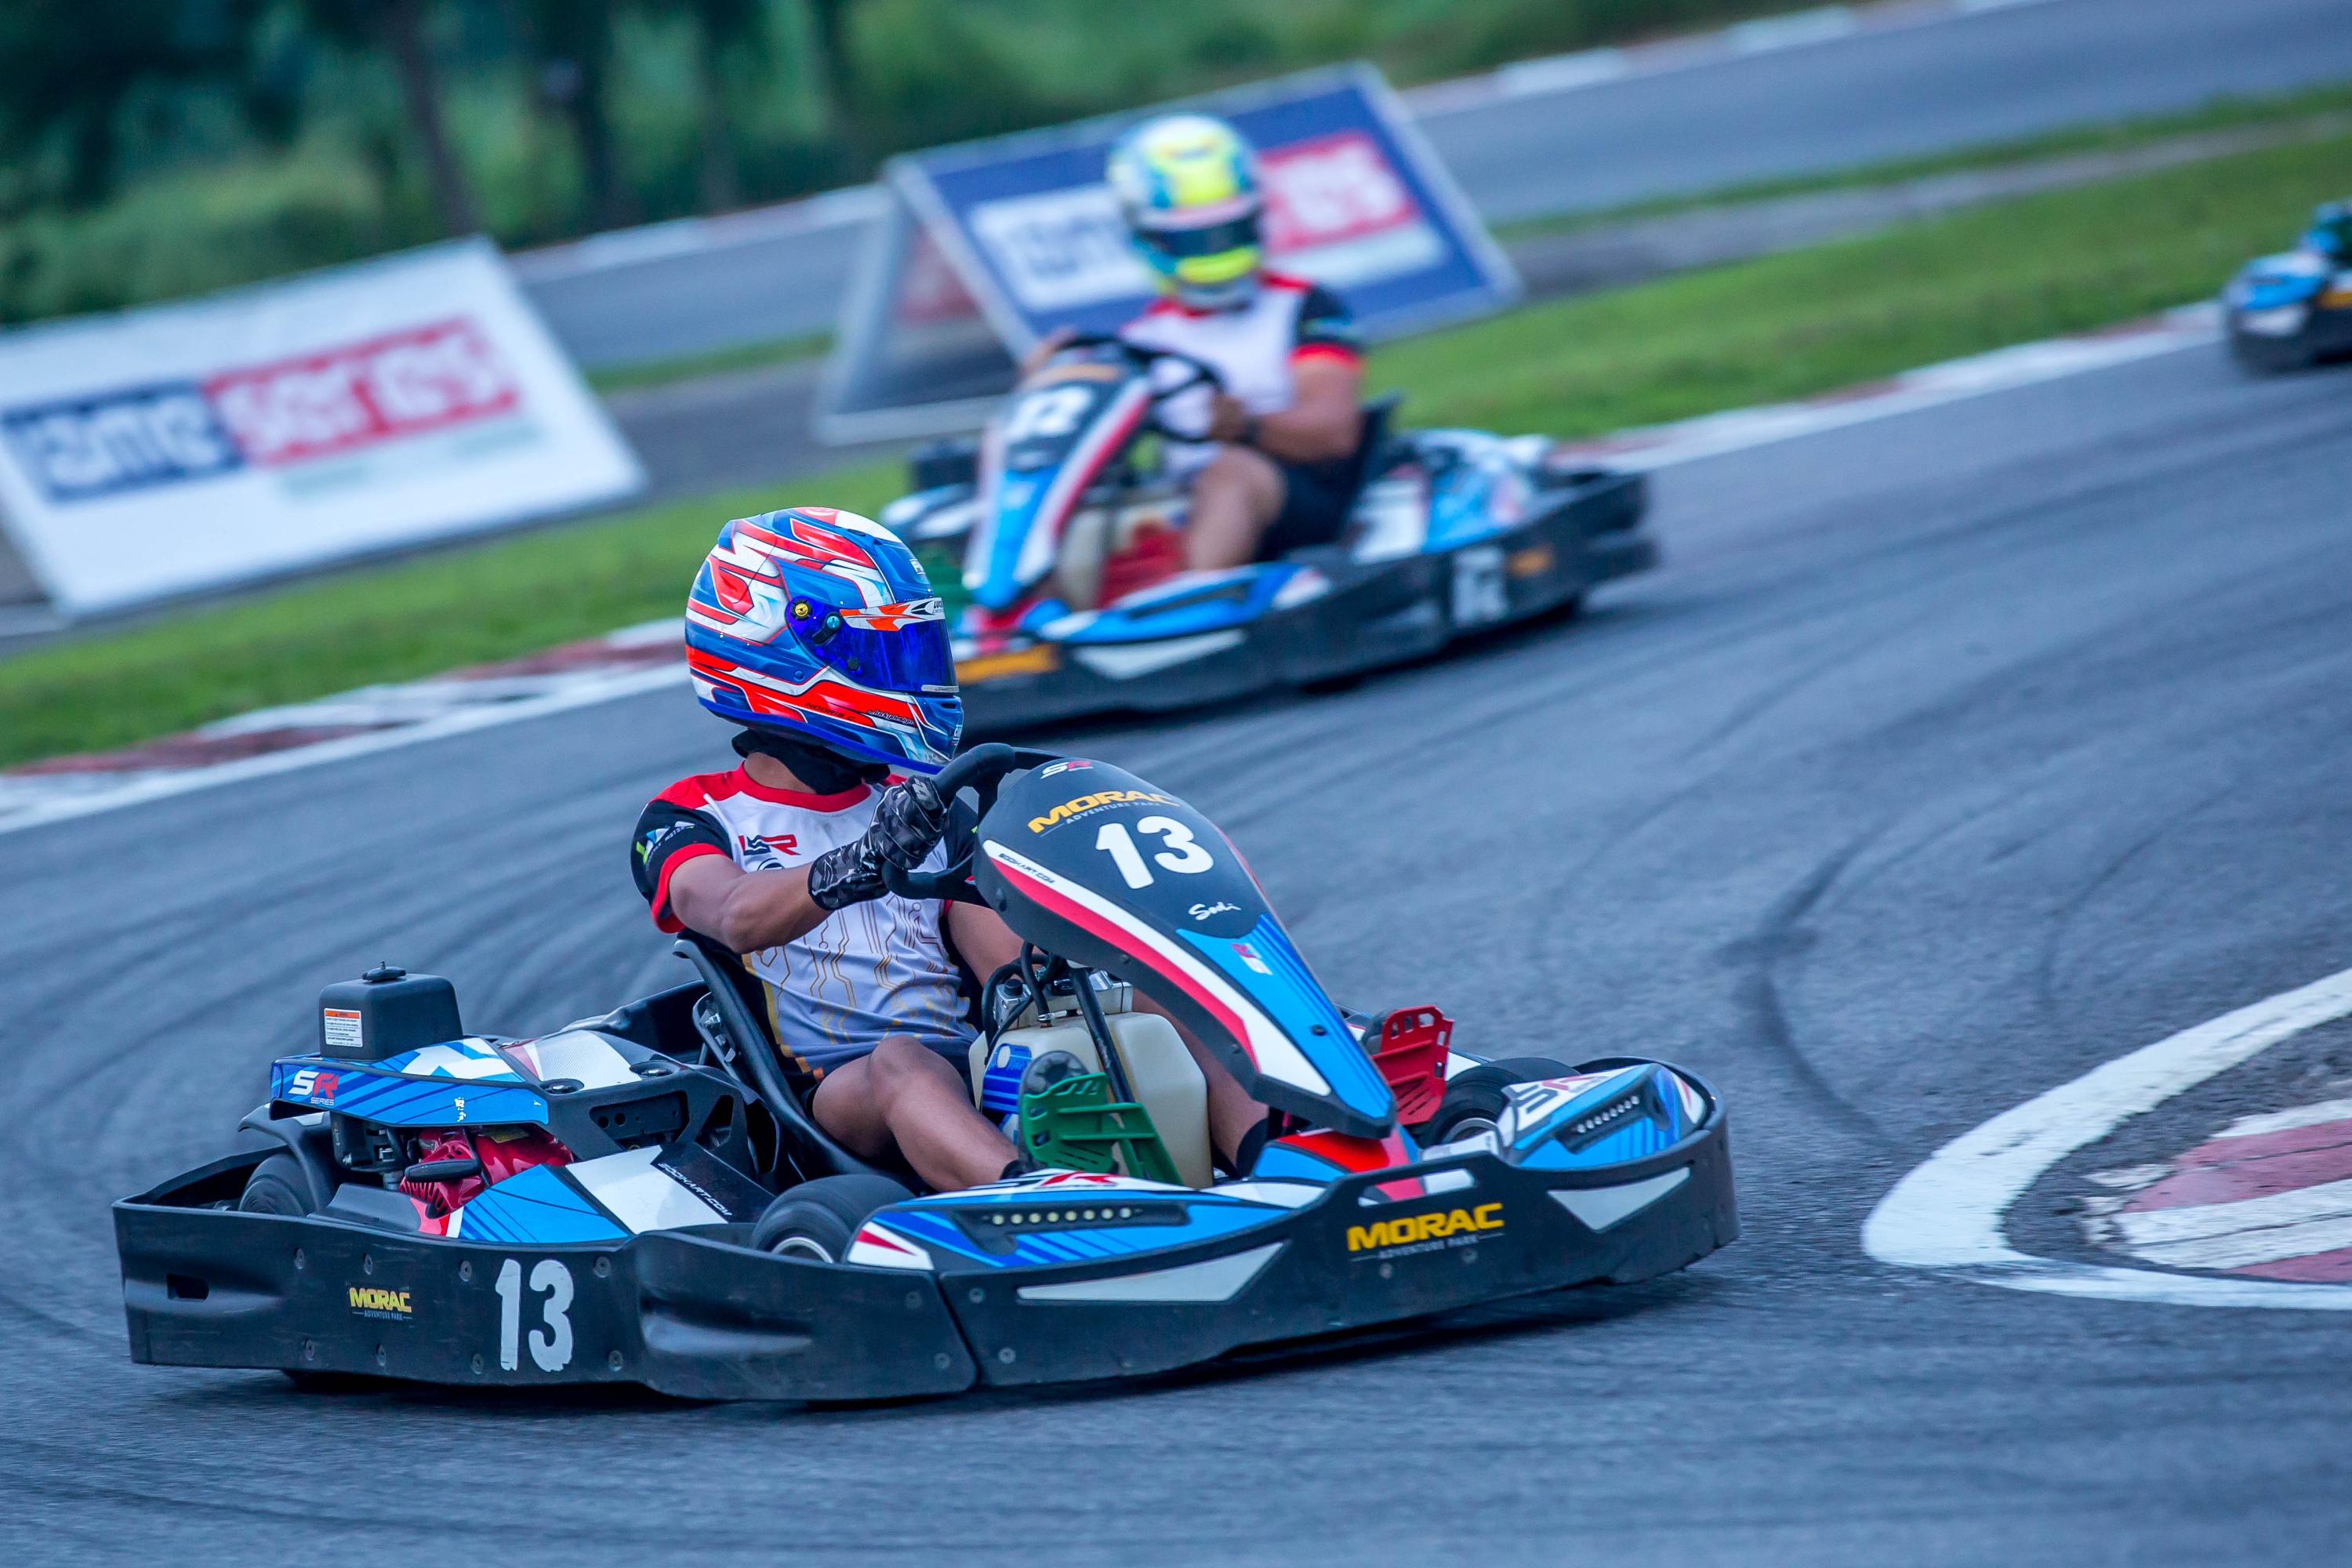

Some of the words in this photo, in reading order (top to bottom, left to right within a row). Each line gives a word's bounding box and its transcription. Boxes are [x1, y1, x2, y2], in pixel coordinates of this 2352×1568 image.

[1027, 790, 1180, 833] MORAC
[1066, 801, 1131, 824] ADVENTURE
[1095, 815, 1214, 890] 13
[288, 1069, 339, 1100] SR
[310, 1097, 336, 1106] SERIES
[1347, 1202, 1505, 1252] MORAC
[349, 1287, 412, 1313] MORAC
[495, 1258, 575, 1373] 13
